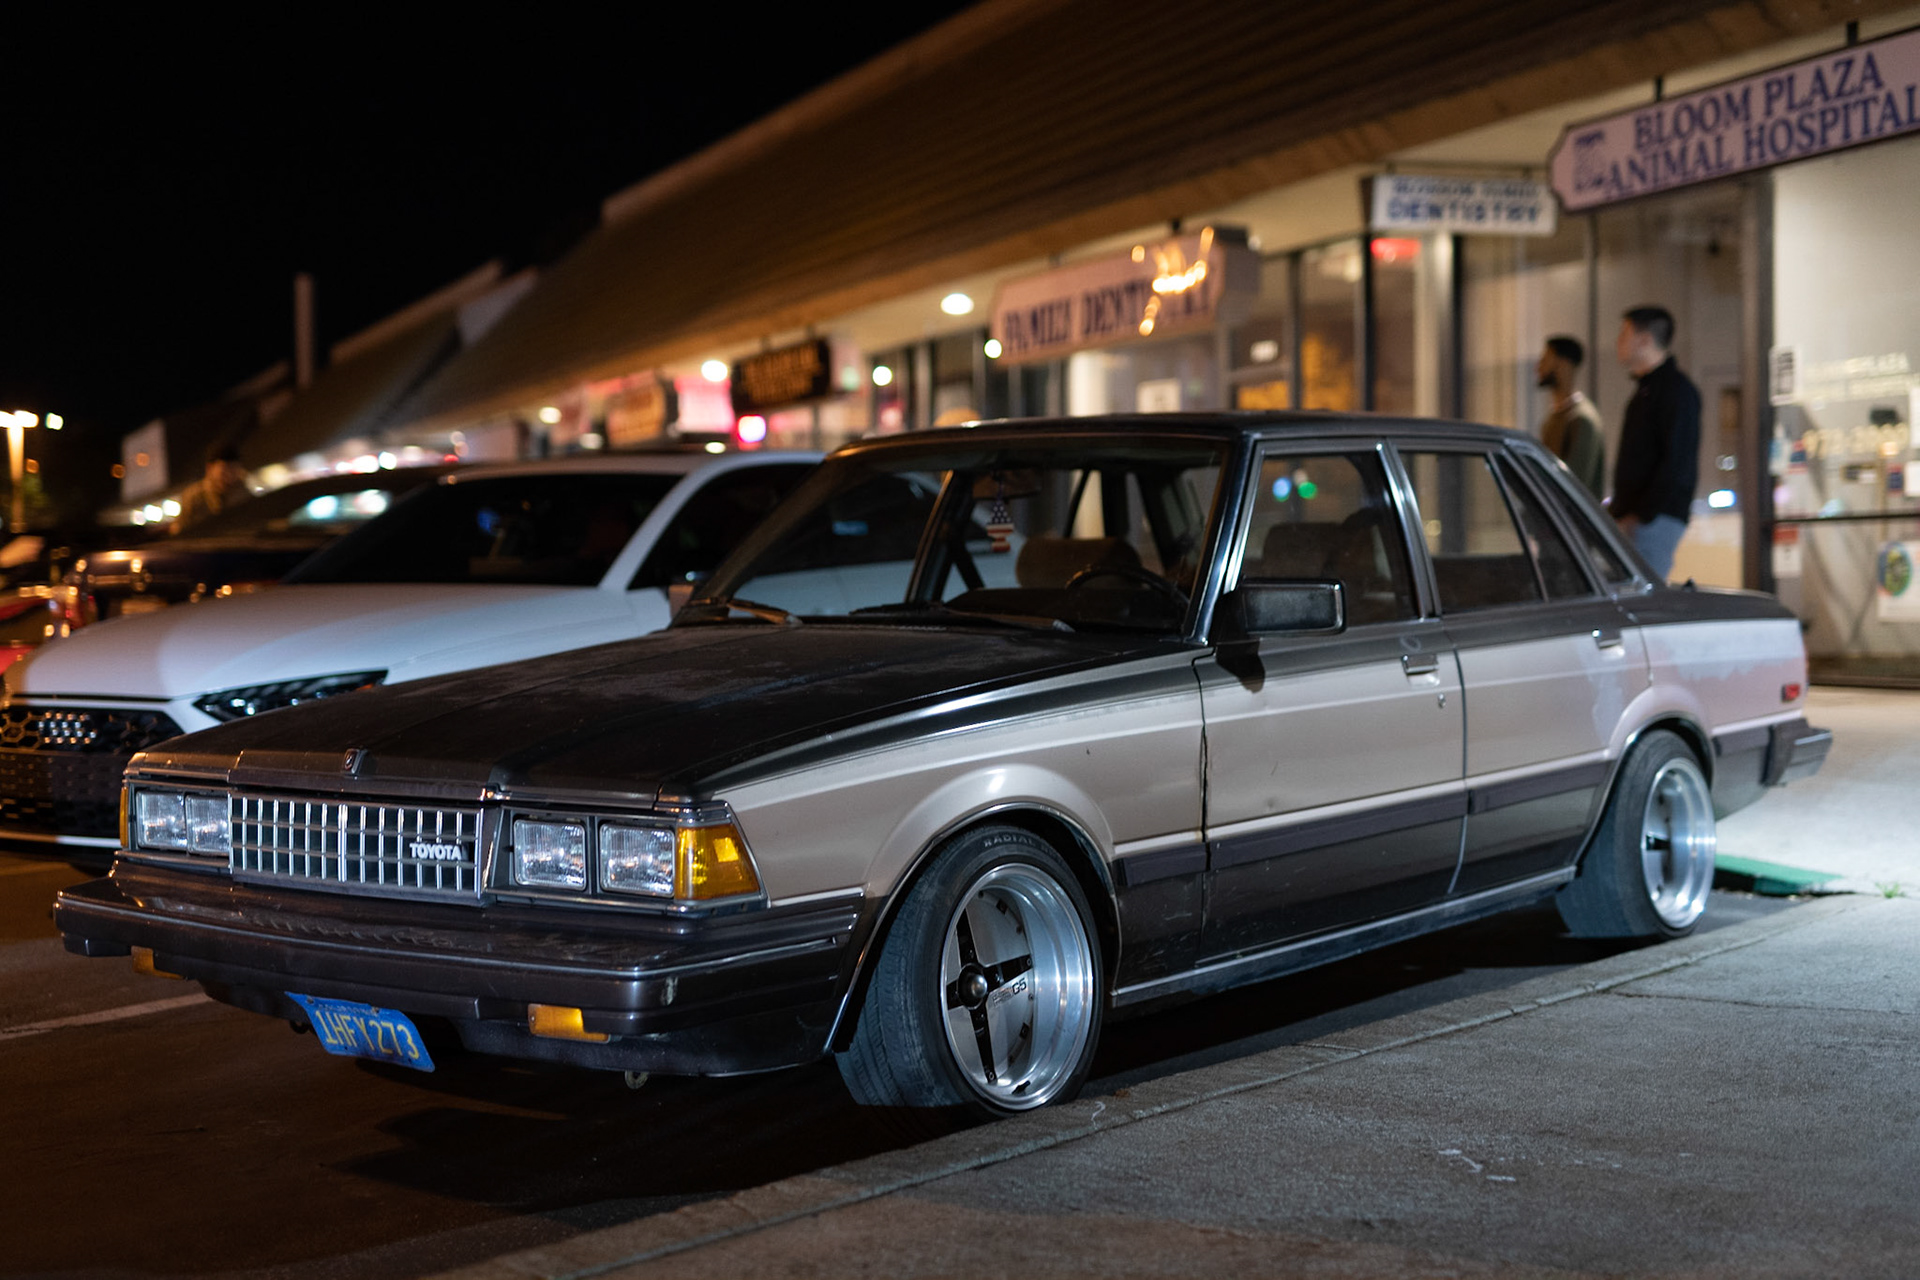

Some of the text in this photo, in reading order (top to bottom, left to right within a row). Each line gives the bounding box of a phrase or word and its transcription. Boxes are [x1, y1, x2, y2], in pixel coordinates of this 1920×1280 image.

[1634, 51, 1884, 150] BLOOM PLAZA
[1605, 85, 1920, 197] ANIMAL HOSPITAL
[409, 842, 462, 861] TOYOTA
[984, 833, 1036, 848] RADIAL
[315, 1009, 420, 1060] 1HFY273
